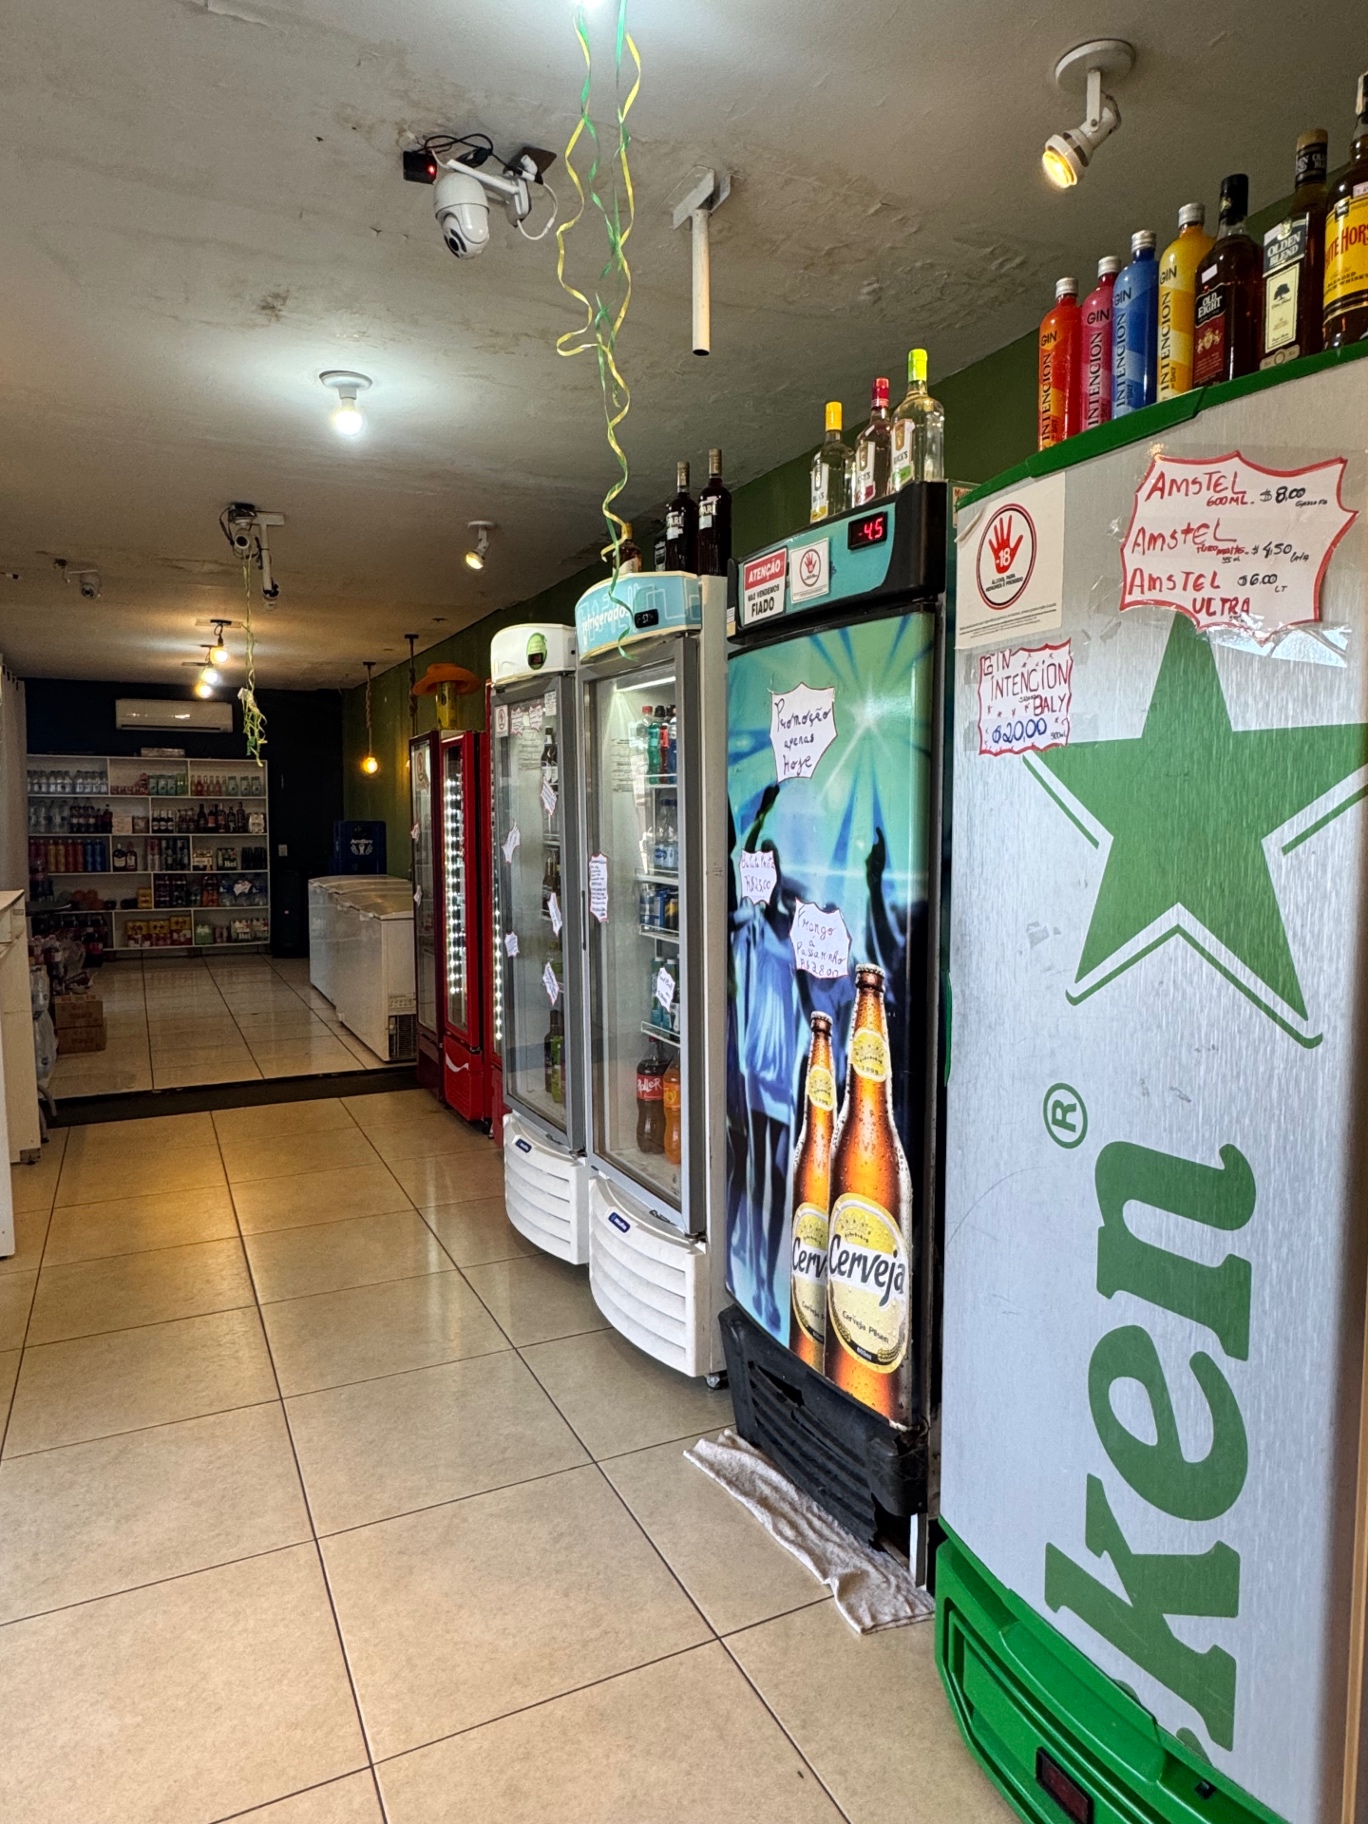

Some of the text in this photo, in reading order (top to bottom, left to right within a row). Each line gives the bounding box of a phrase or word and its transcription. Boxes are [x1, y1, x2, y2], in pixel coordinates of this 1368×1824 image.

[1267, 231, 1301, 258] OLDEN
[1269, 244, 1299, 267] BLEND
[1160, 265, 1177, 285] GIN
[1114, 287, 1132, 307] GIN
[1198, 296, 1223, 319] EIGHT
[1202, 292, 1217, 307] OLD
[1087, 308, 1110, 325] GIN
[1040, 330, 1057, 347] GIN
[1161, 291, 1171, 391] INTENCION
[1116, 312, 1126, 407] INTENCION
[1088, 331, 1102, 426] INTENCION
[1041, 353, 1051, 440] INTENCION
[1145, 471, 1247, 502] AMSTEL
[748, 559, 781, 583] ATENÇÃO
[751, 597, 775, 617] FIADO
[1192, 596, 1251, 617] ULTRA
[983, 649, 1013, 676] GIN
[774, 698, 832, 732] Promoção
[1033, 693, 1067, 717] BALY
[784, 733, 815, 751] apenas
[792, 1237, 829, 1279] Cerv
[829, 1234, 906, 1307] Cerveja
[842, 1310, 866, 1331] Cerveja
